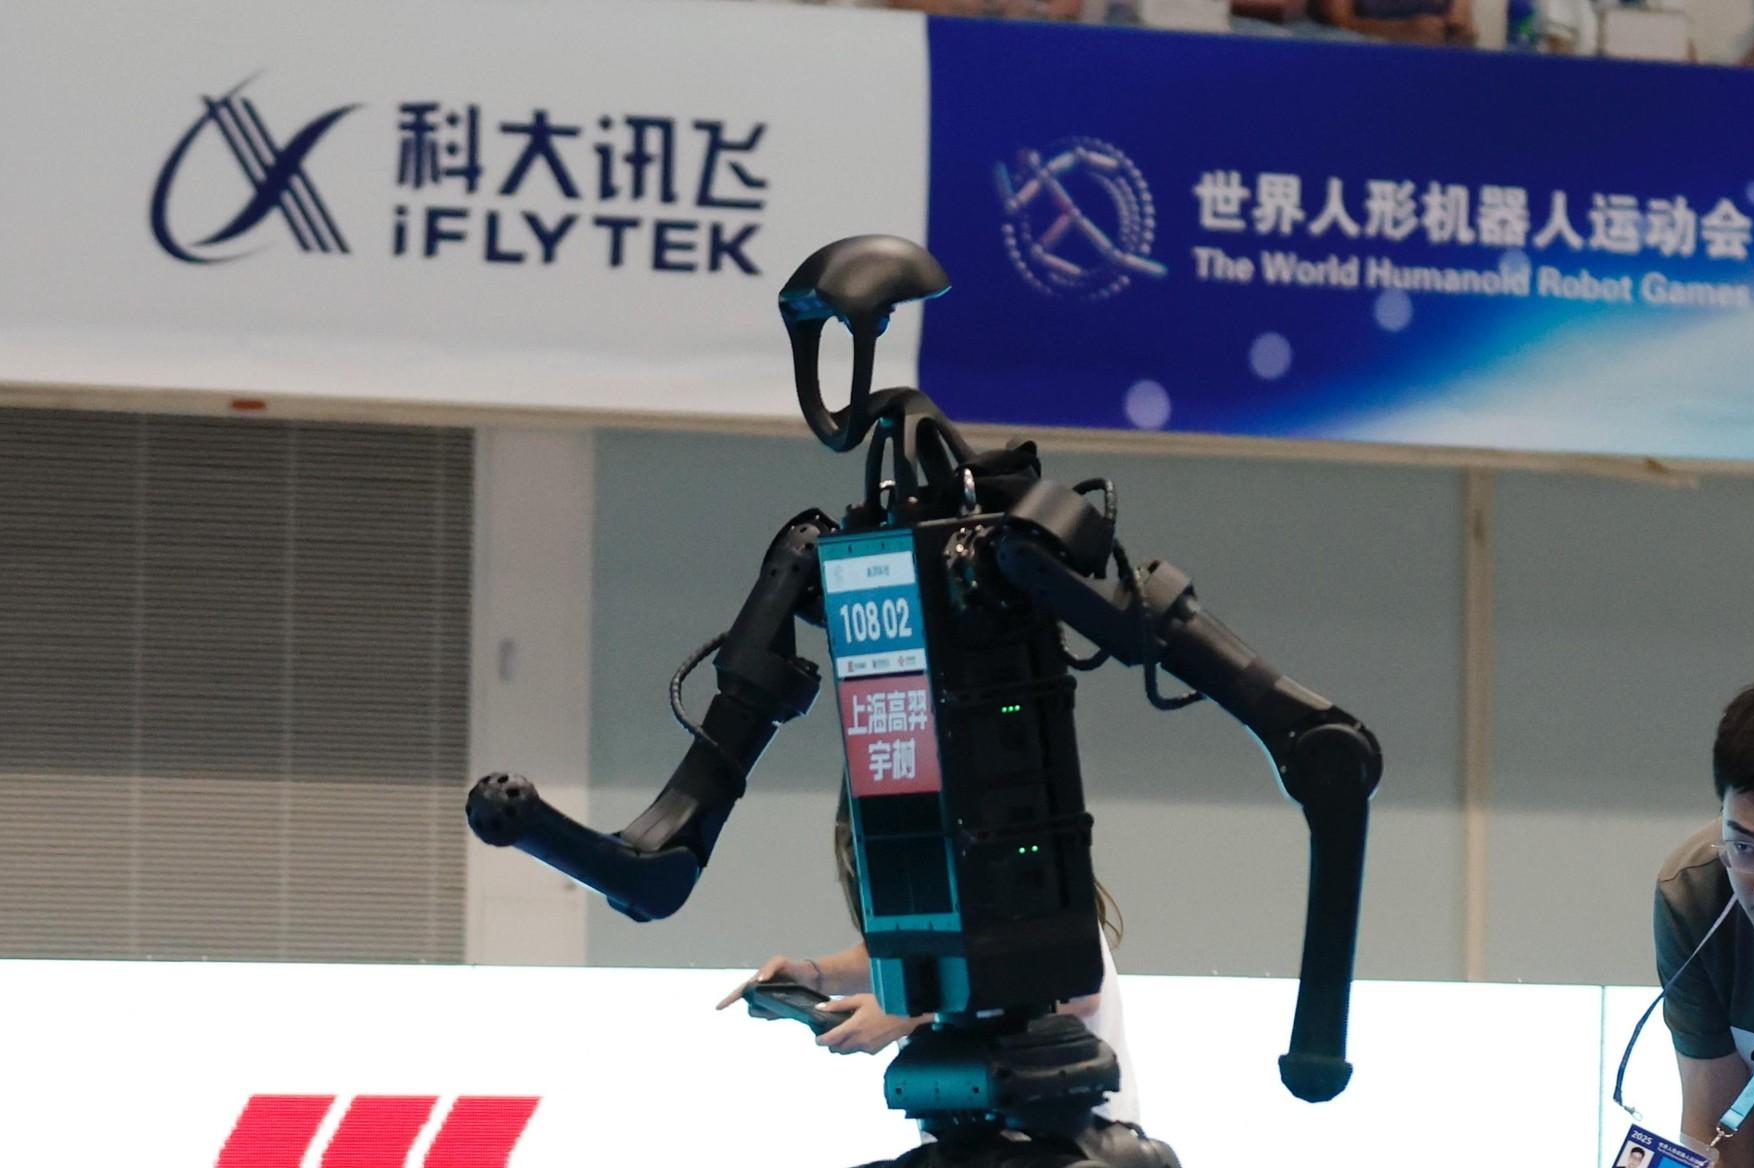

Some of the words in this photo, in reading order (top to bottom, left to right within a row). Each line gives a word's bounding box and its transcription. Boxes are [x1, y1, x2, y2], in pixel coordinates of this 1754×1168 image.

[395, 102, 768, 210] 科大讯飞
[393, 205, 763, 276] iFLYTEK
[1193, 170, 1753, 260] 世界人形机器人运动会
[1194, 246, 1254, 281] The
[1261, 250, 1361, 287] World
[1365, 255, 1531, 297] Humanoid
[1536, 264, 1633, 302] Robot
[1639, 271, 1750, 304] Games
[1631, 1130, 1653, 1146] 2025
